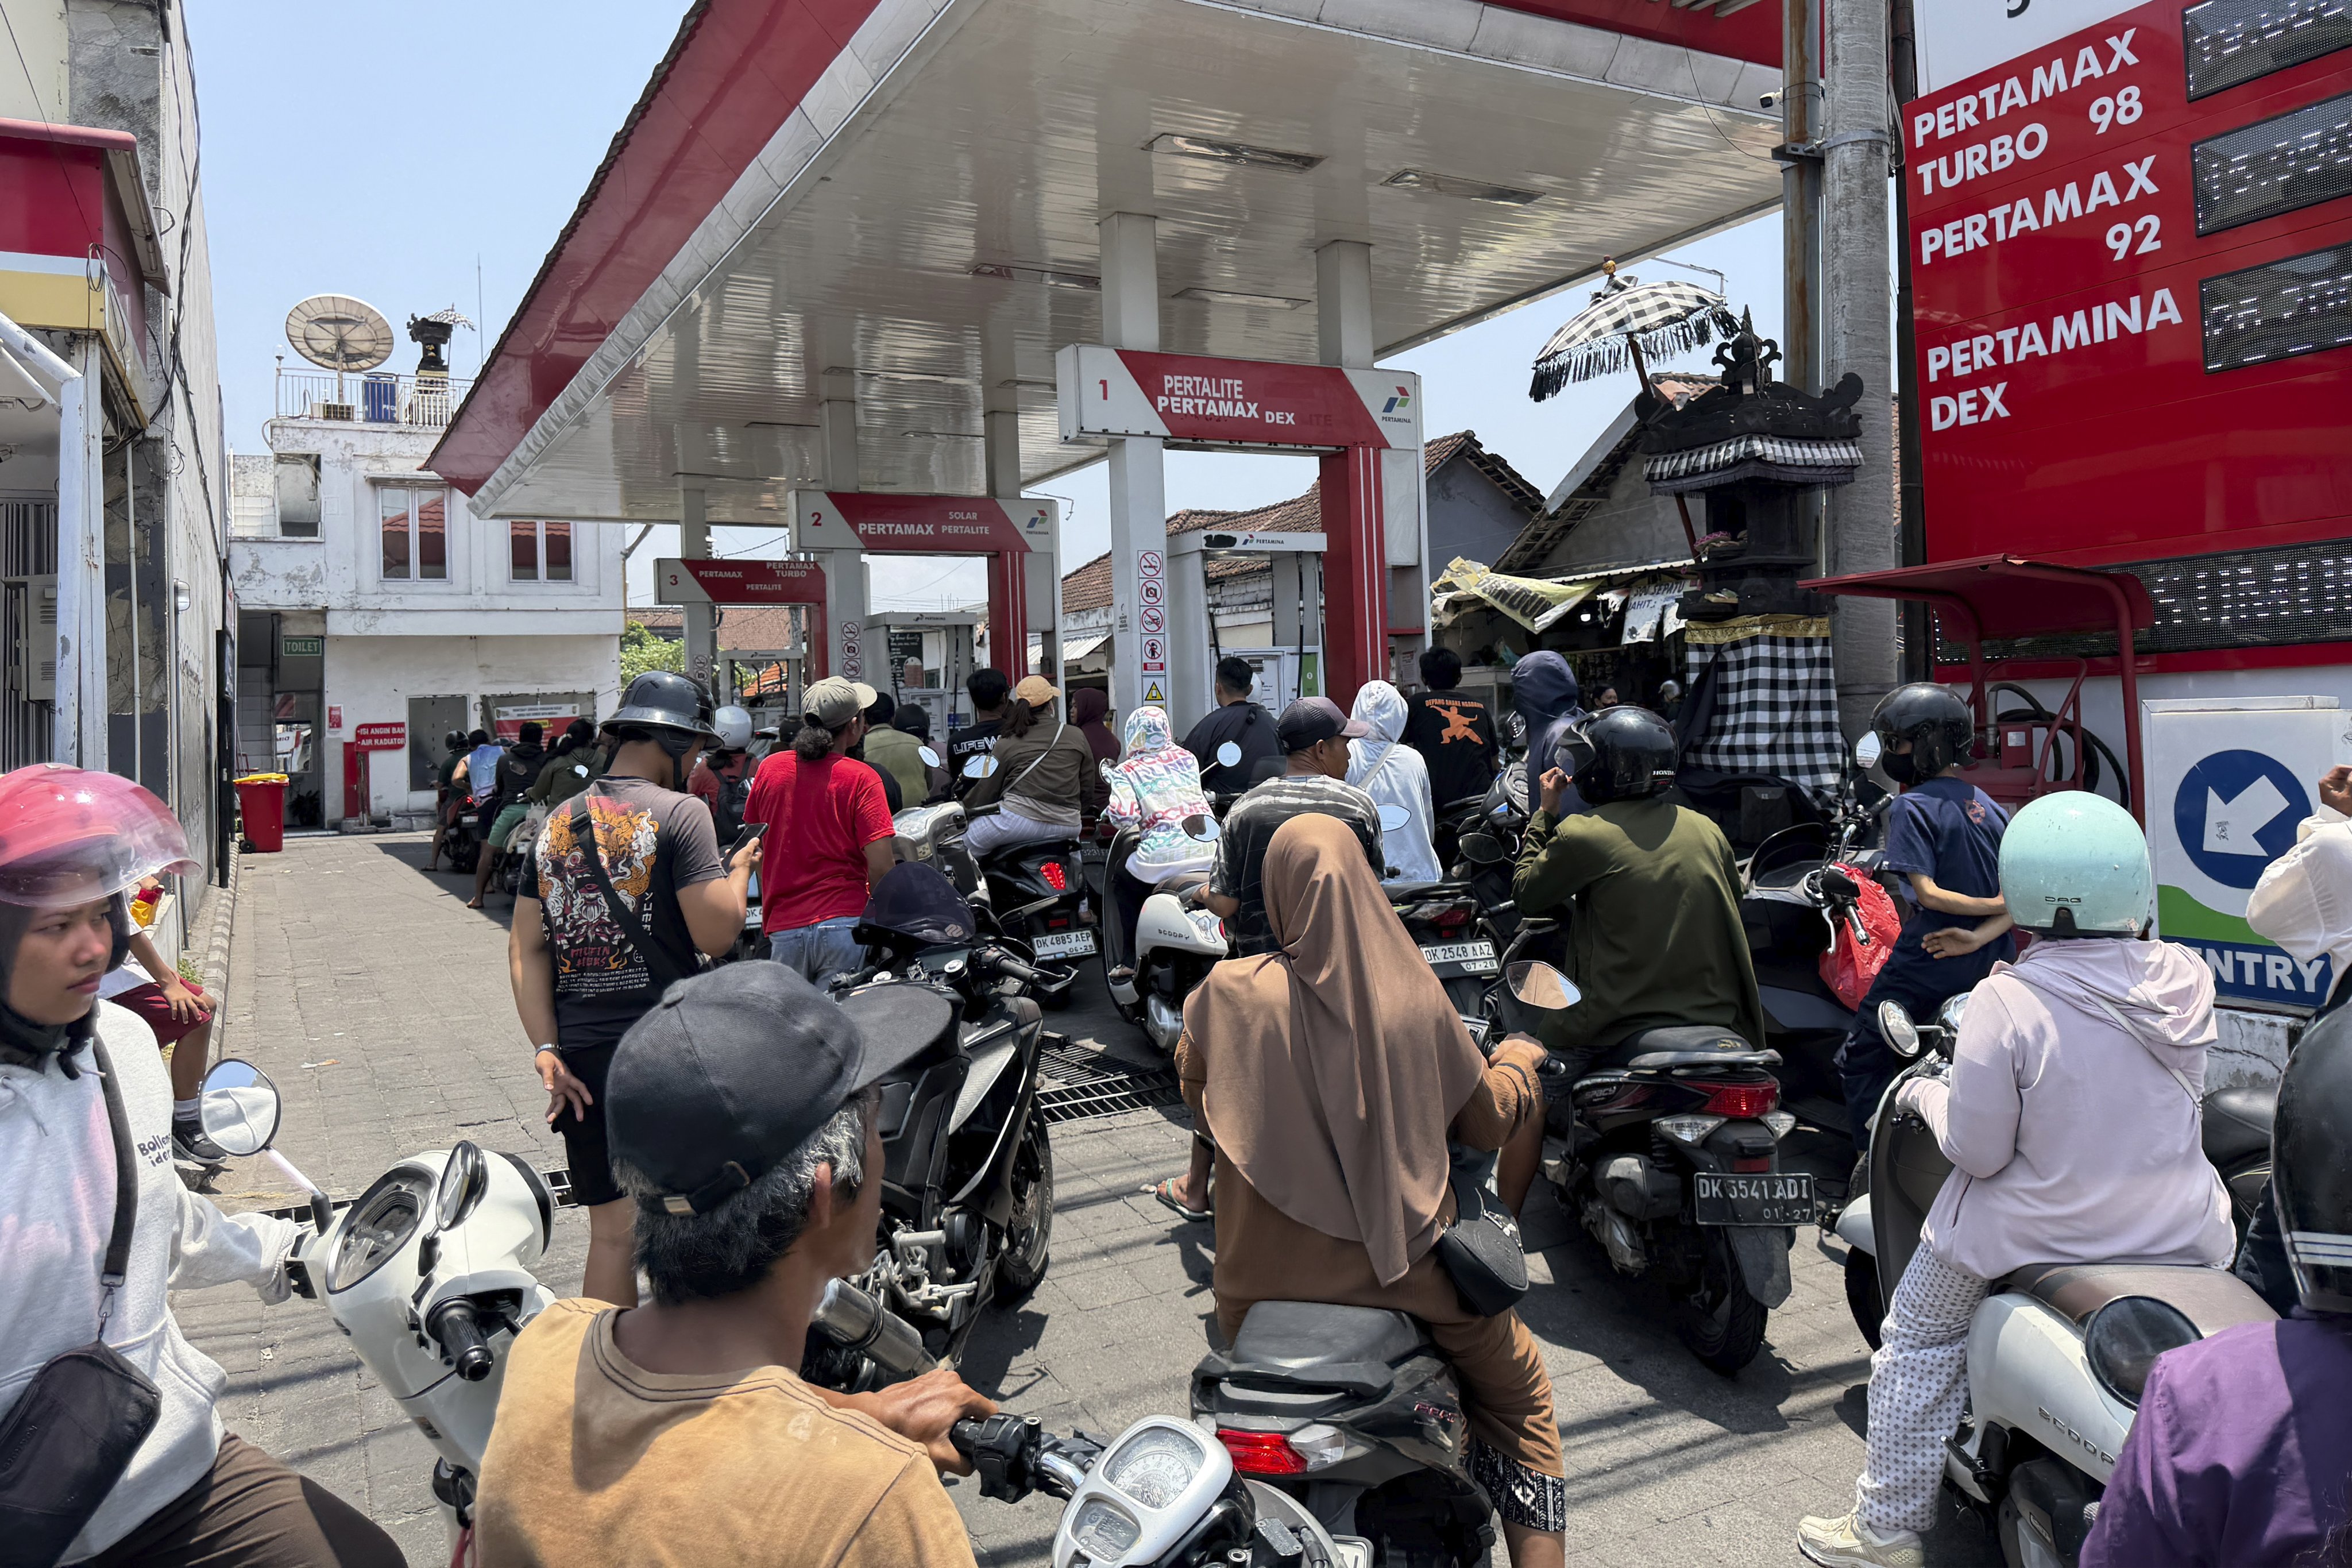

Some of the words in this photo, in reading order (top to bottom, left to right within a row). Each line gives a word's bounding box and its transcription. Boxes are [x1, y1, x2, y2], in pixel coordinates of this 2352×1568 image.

[1915, 28, 2139, 148] PERTAMAX
[1917, 123, 2048, 195] TURBO
[2088, 86, 2143, 134] 98
[1922, 155, 2160, 265] PERTAMAX
[2106, 215, 2161, 261] 92
[1928, 288, 2182, 382] PERTAMINA
[1098, 379, 1109, 401] 1
[1164, 374, 1243, 399] PERTALITE
[1158, 396, 1259, 418] PERTAMAX
[1265, 411, 1295, 425] DEX
[1930, 382, 2011, 431] DEX
[811, 512, 822, 527] 2
[949, 512, 978, 520] SOLAR
[859, 523, 934, 535] PERTAMAX
[941, 525, 990, 535] PERTALITE
[698, 570, 743, 578] PERTAMAX
[766, 562, 815, 570] PERTAMAX
[775, 570, 806, 578] TURBO
[670, 575, 678, 586] 3
[1652, 580, 1686, 595] SEPATU
[285, 642, 318, 652] TOILET
[1036, 938, 1049, 949] DK
[1051, 933, 1072, 946] 4885
[1075, 931, 1091, 943] AEP
[1158, 928, 1189, 940] SCOOPY
[1424, 948, 1440, 961] DK
[1442, 945, 1468, 960] 2548
[1472, 941, 1493, 956] AAZ
[2191, 948, 2325, 993] NTRY
[1698, 1179, 1723, 1198] DK
[1726, 1180, 1769, 1200] 5541
[1772, 1179, 1809, 1199] ADI
